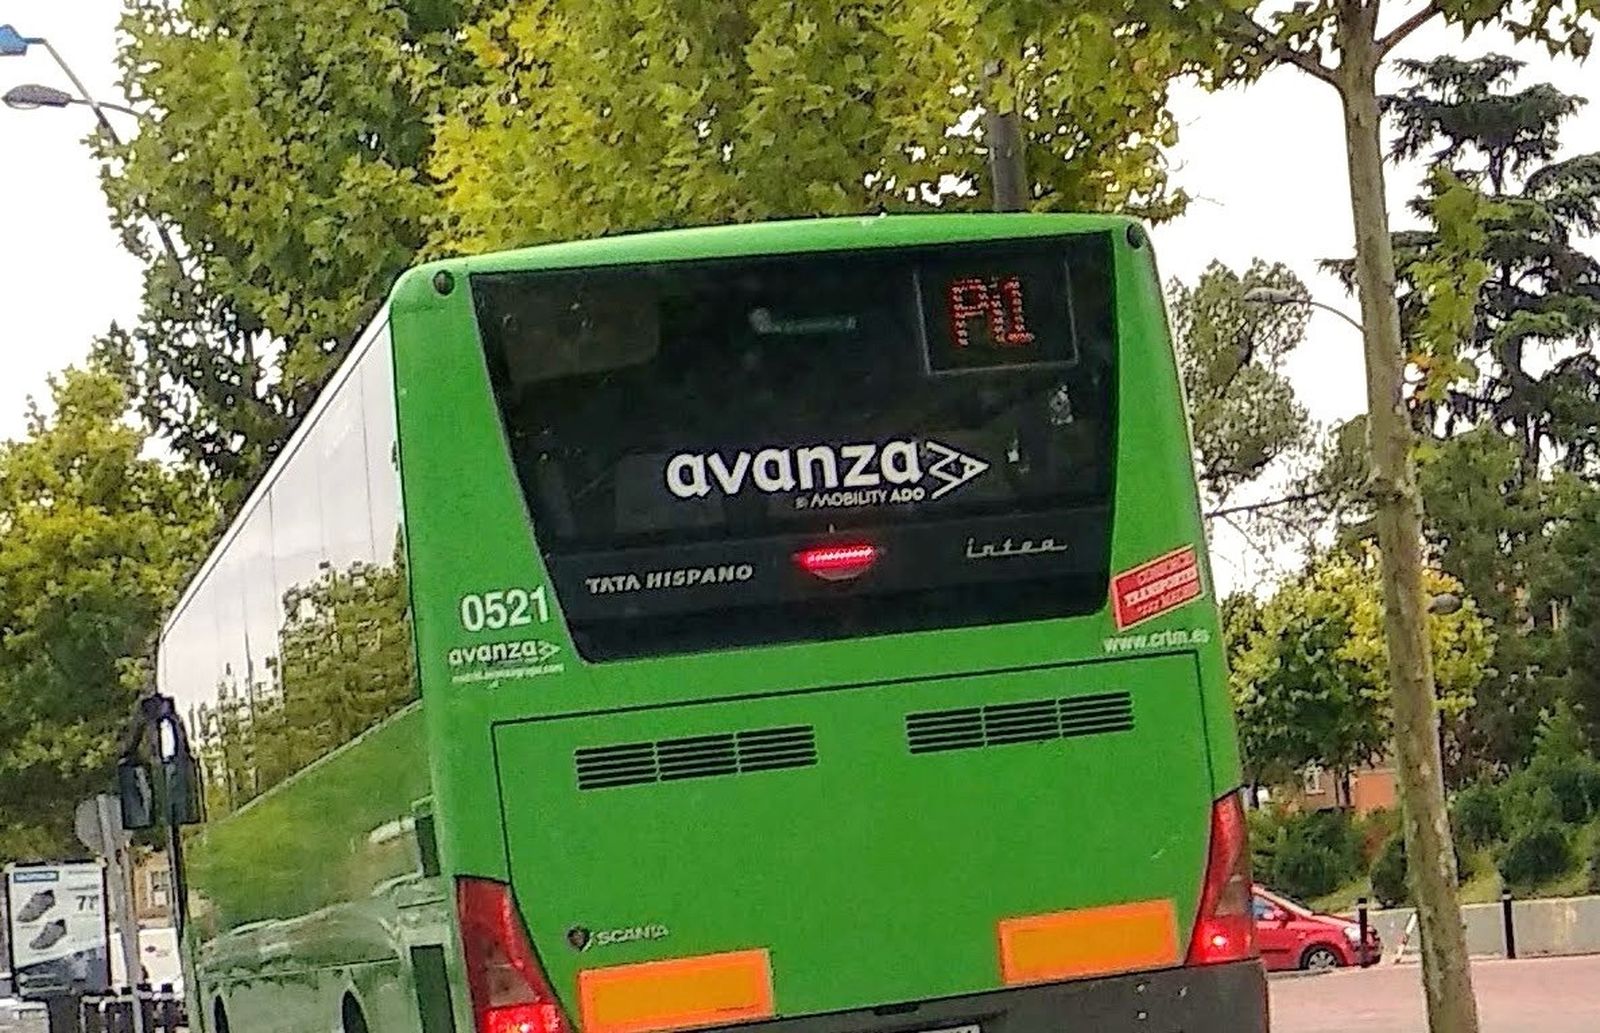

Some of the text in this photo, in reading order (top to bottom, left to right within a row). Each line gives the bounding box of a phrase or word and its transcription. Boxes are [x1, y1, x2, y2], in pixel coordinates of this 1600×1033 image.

[666, 440, 923, 498] avanza
[889, 486, 926, 503] ADO
[585, 563, 754, 594] TATA HISPANO
[461, 585, 549, 632] 0521
[449, 640, 538, 666] avanza
